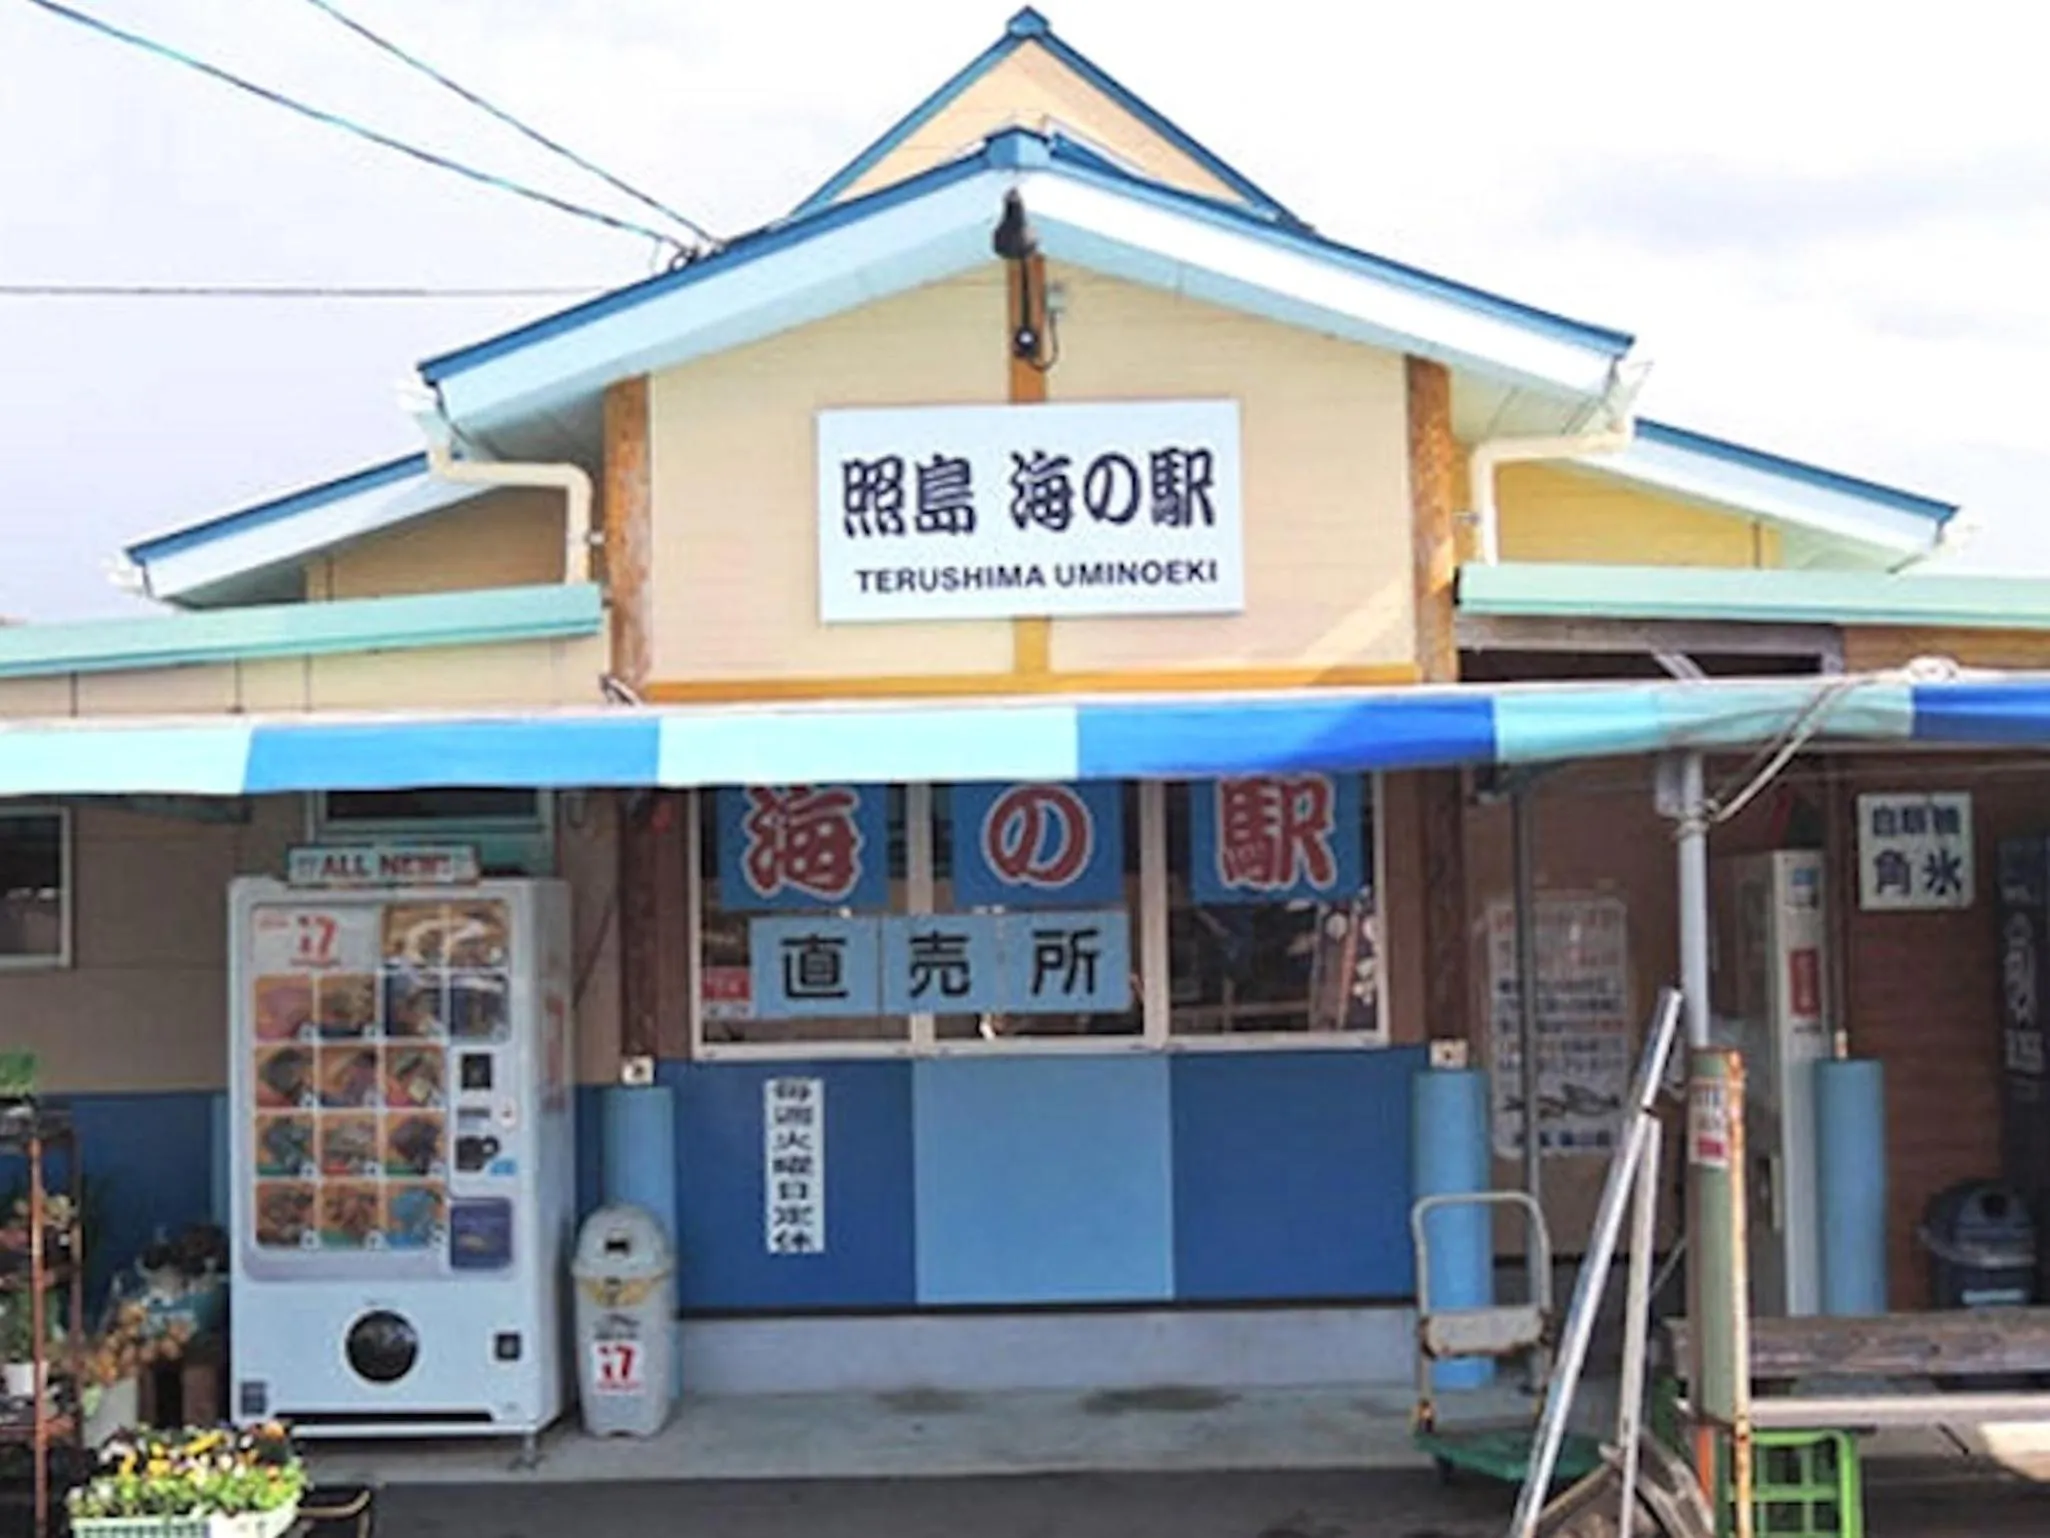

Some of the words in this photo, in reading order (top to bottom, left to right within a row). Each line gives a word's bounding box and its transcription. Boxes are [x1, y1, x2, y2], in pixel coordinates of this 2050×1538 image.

[842, 454, 976, 537] 照島
[1009, 447, 1216, 531] 海の駅
[856, 564, 1046, 593] TERUSHIMA
[1054, 559, 1218, 586] UMINOEKI
[321, 855, 371, 876] ALL
[743, 779, 1334, 893] 海の駅
[781, 928, 1104, 1001] 直売所
